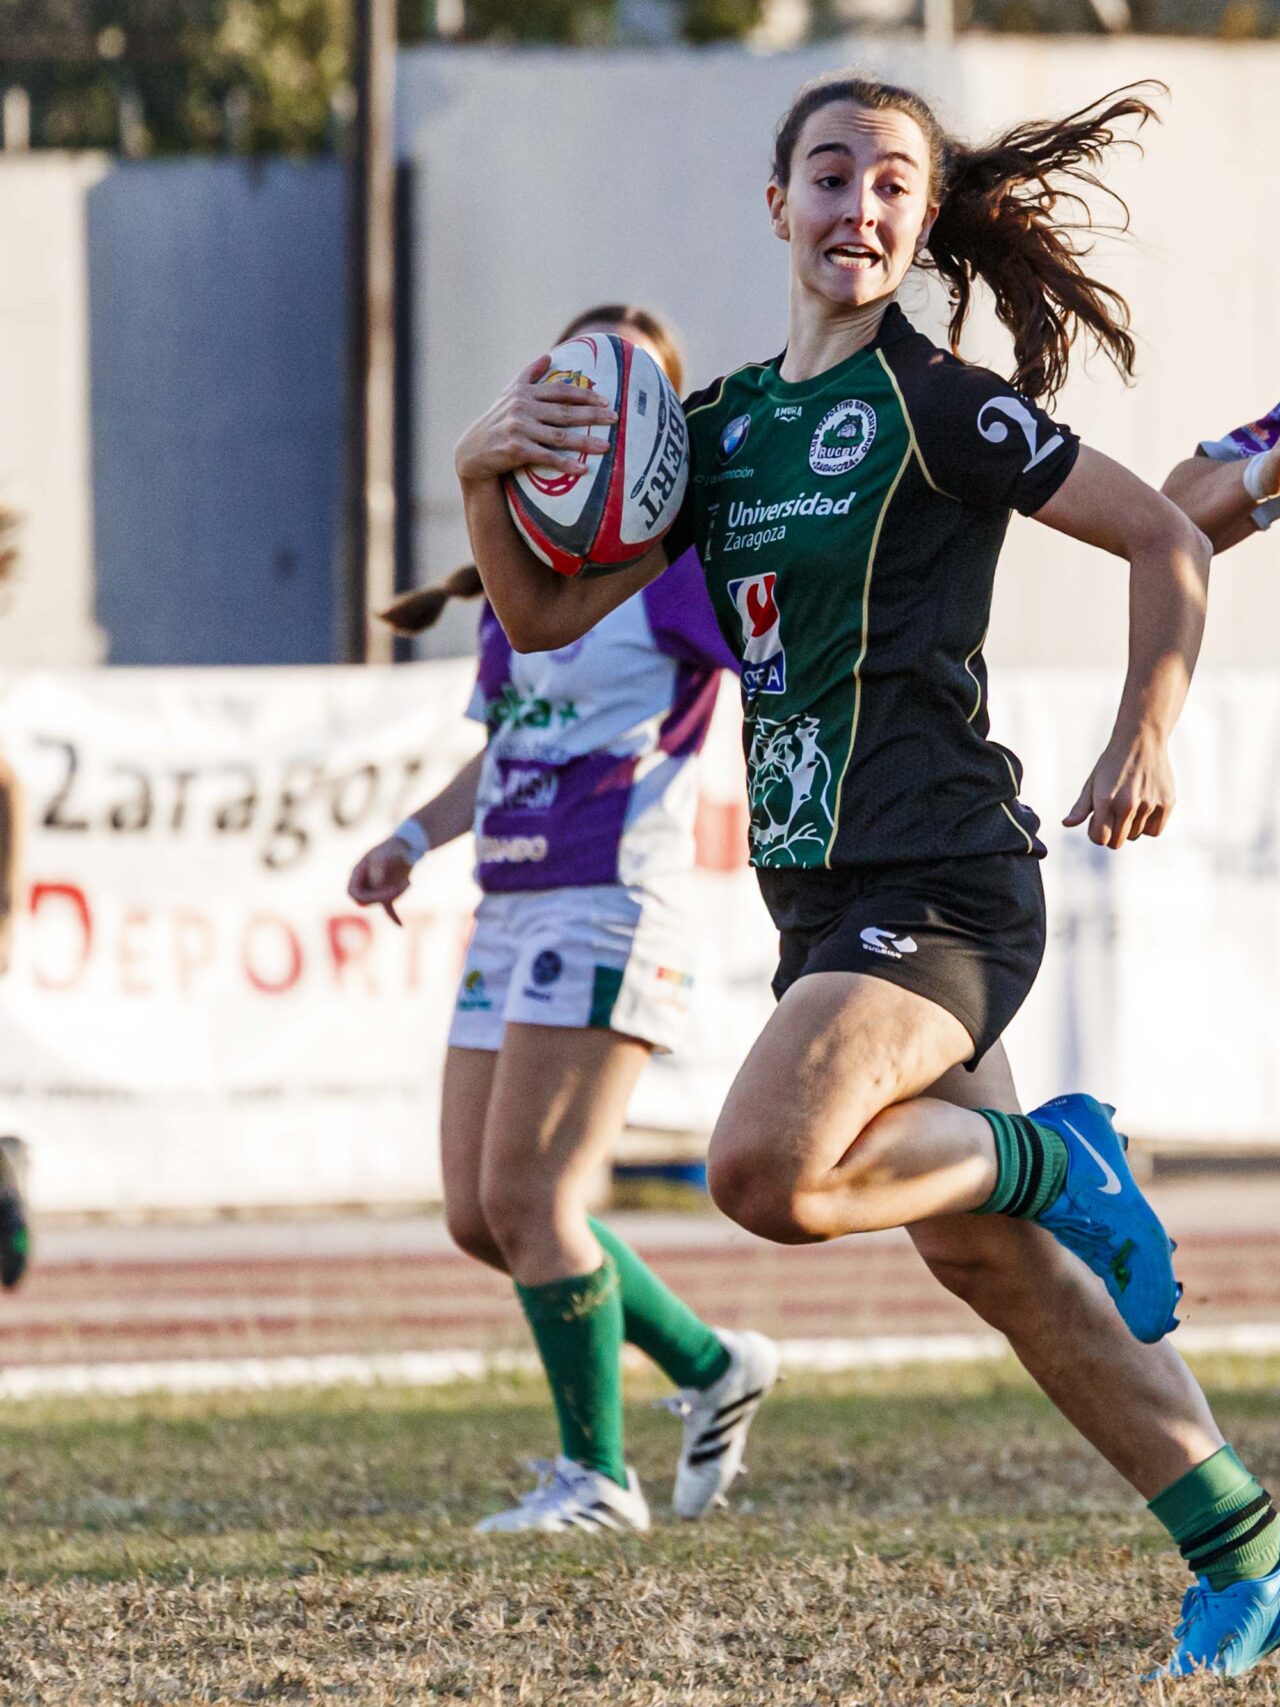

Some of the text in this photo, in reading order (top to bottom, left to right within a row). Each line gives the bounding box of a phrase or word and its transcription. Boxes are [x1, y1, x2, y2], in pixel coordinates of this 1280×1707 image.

[774, 406, 802, 418] AMURA
[977, 396, 1064, 474] 2
[818, 446, 860, 459] RUGBY
[728, 492, 856, 528] Universidad
[723, 525, 786, 551] Zaragoza
[31, 730, 428, 872] Zarago
